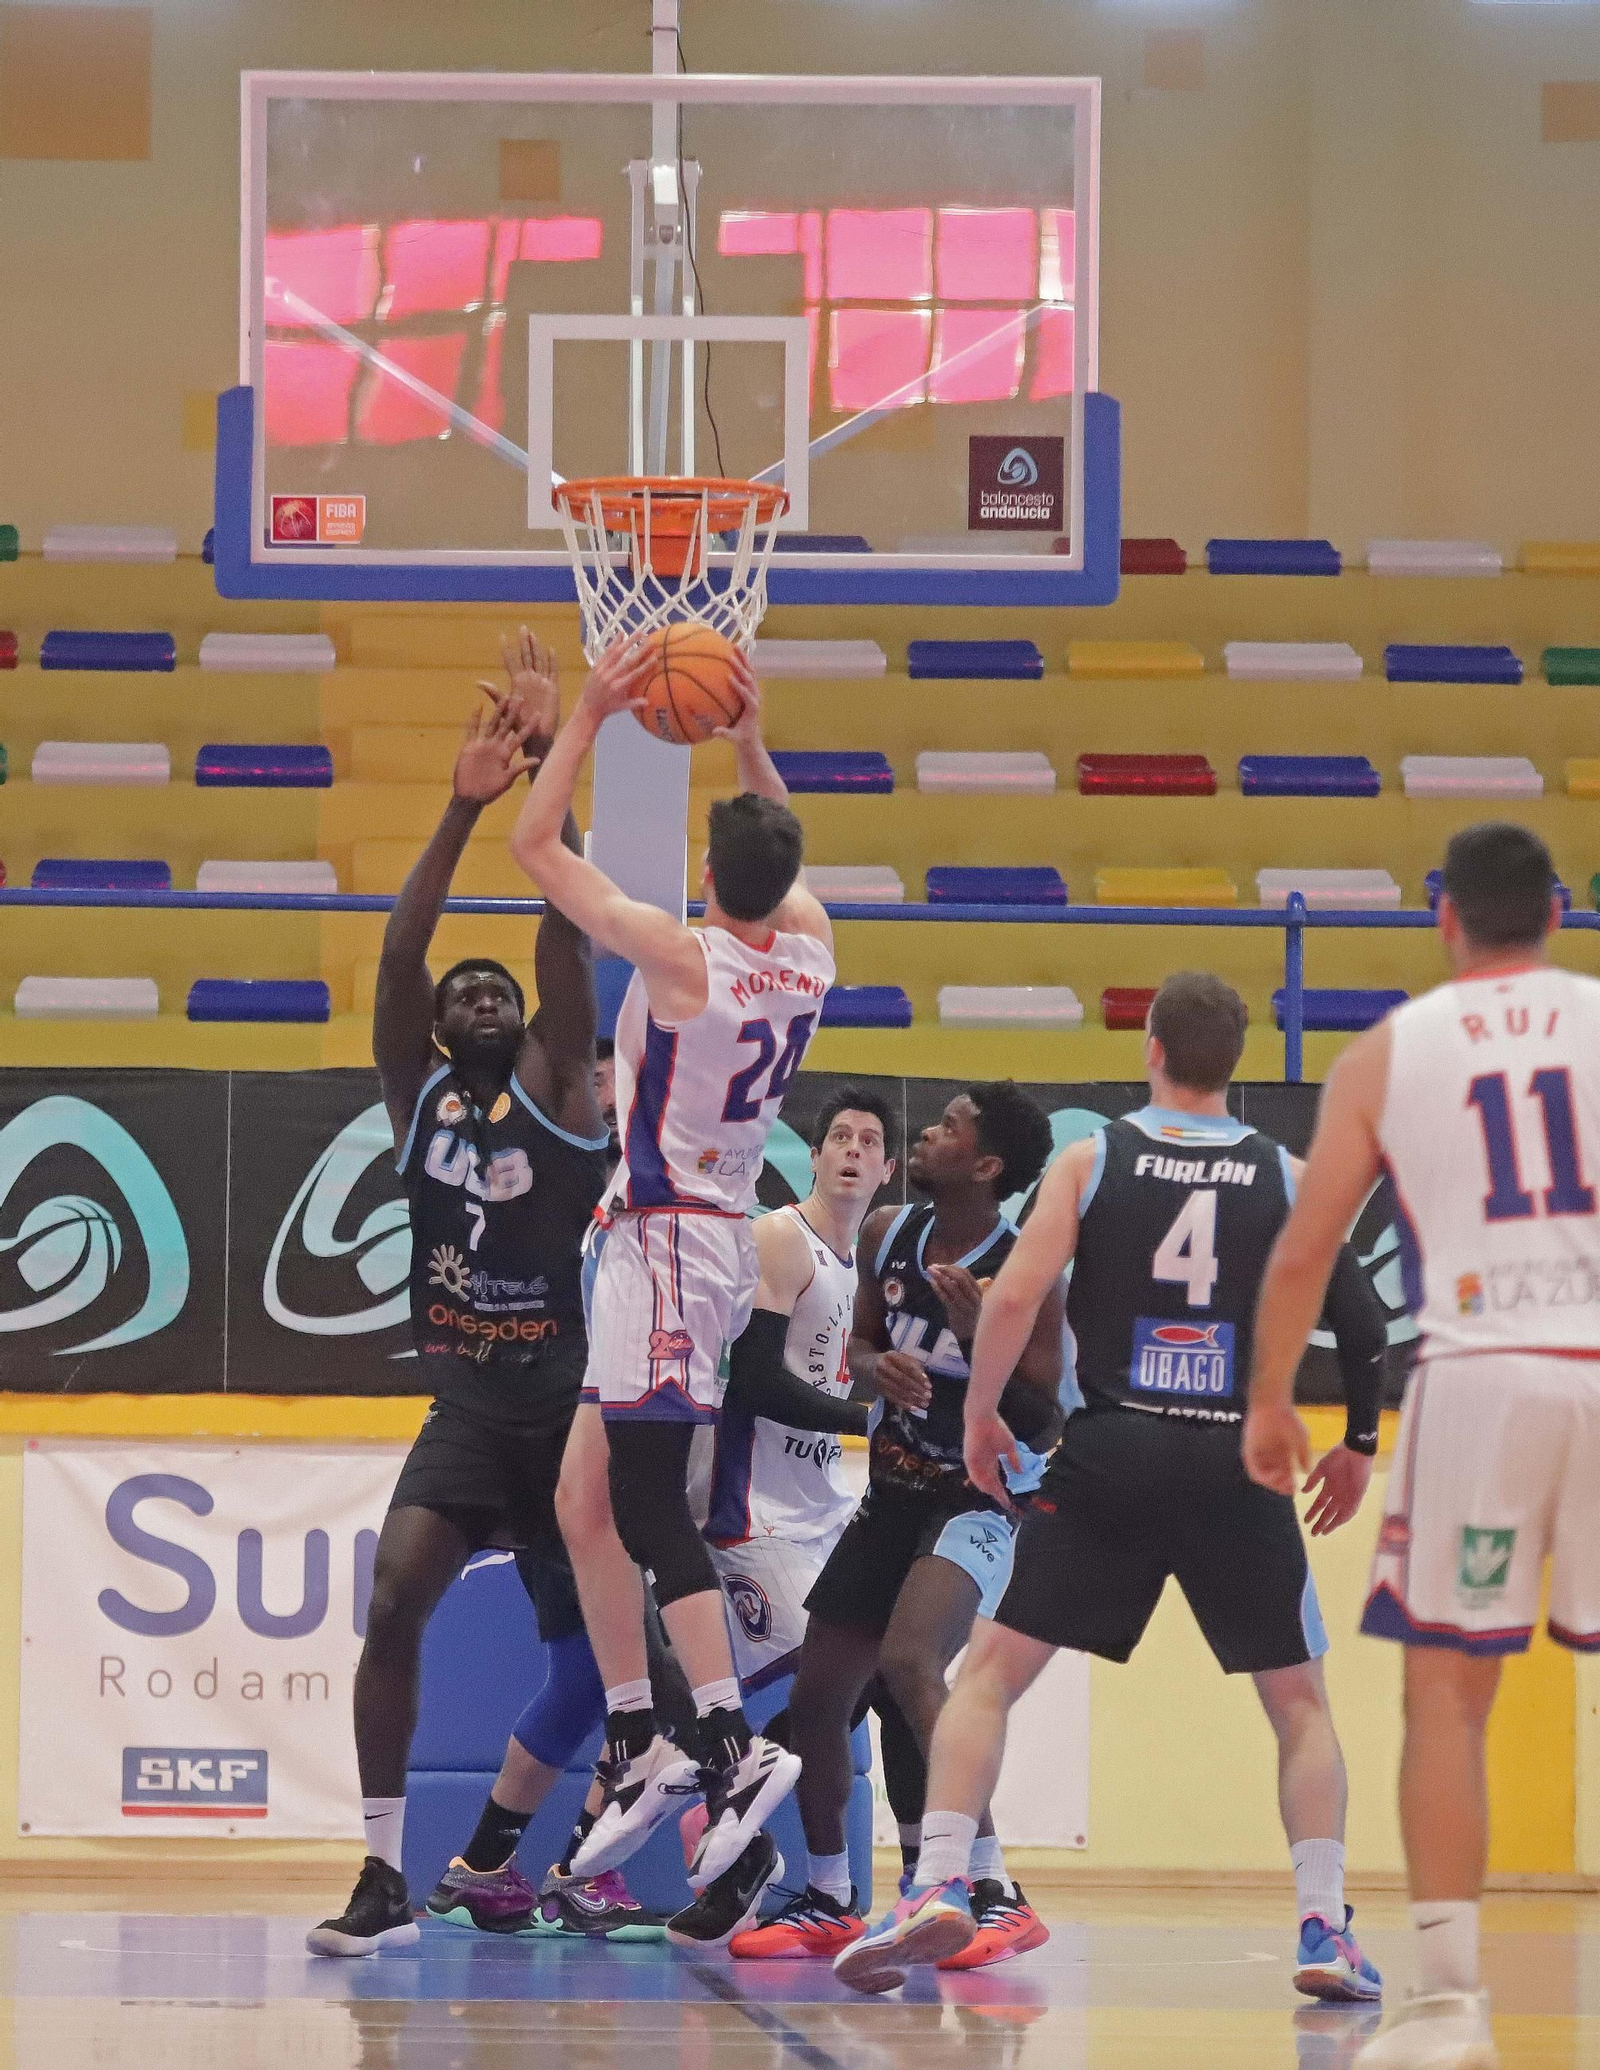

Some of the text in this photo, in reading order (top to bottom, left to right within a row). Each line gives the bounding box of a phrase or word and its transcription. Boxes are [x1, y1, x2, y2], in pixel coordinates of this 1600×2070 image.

[326, 503, 357, 519] FIBA
[981, 490, 1055, 507] baloncesto
[729, 969, 826, 1008] MORENO
[720, 1010, 817, 1123] 24
[1464, 1065, 1597, 1223] 11
[1134, 1153, 1257, 1186] FURLÁN
[465, 1200, 486, 1251] 7
[1152, 1189, 1219, 1307] 4
[1139, 1352, 1225, 1392] UBAGO
[137, 1757, 258, 1792] SKF
